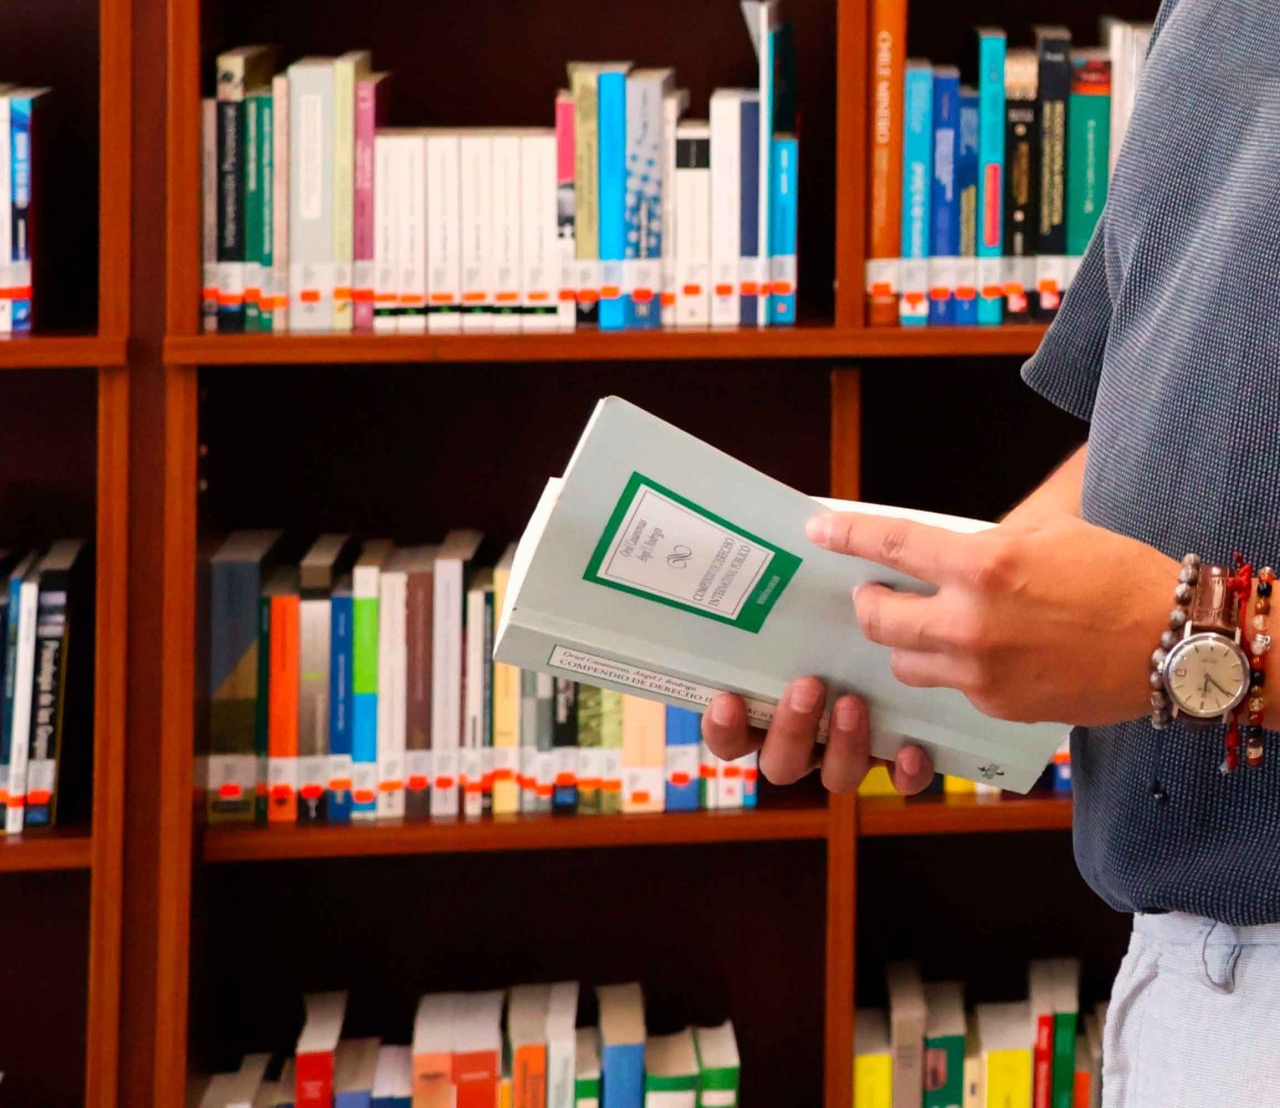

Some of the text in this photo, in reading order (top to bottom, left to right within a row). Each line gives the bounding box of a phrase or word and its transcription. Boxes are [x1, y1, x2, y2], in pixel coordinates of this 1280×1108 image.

[559, 658, 703, 702] COMPENDIO DE DERECHO
